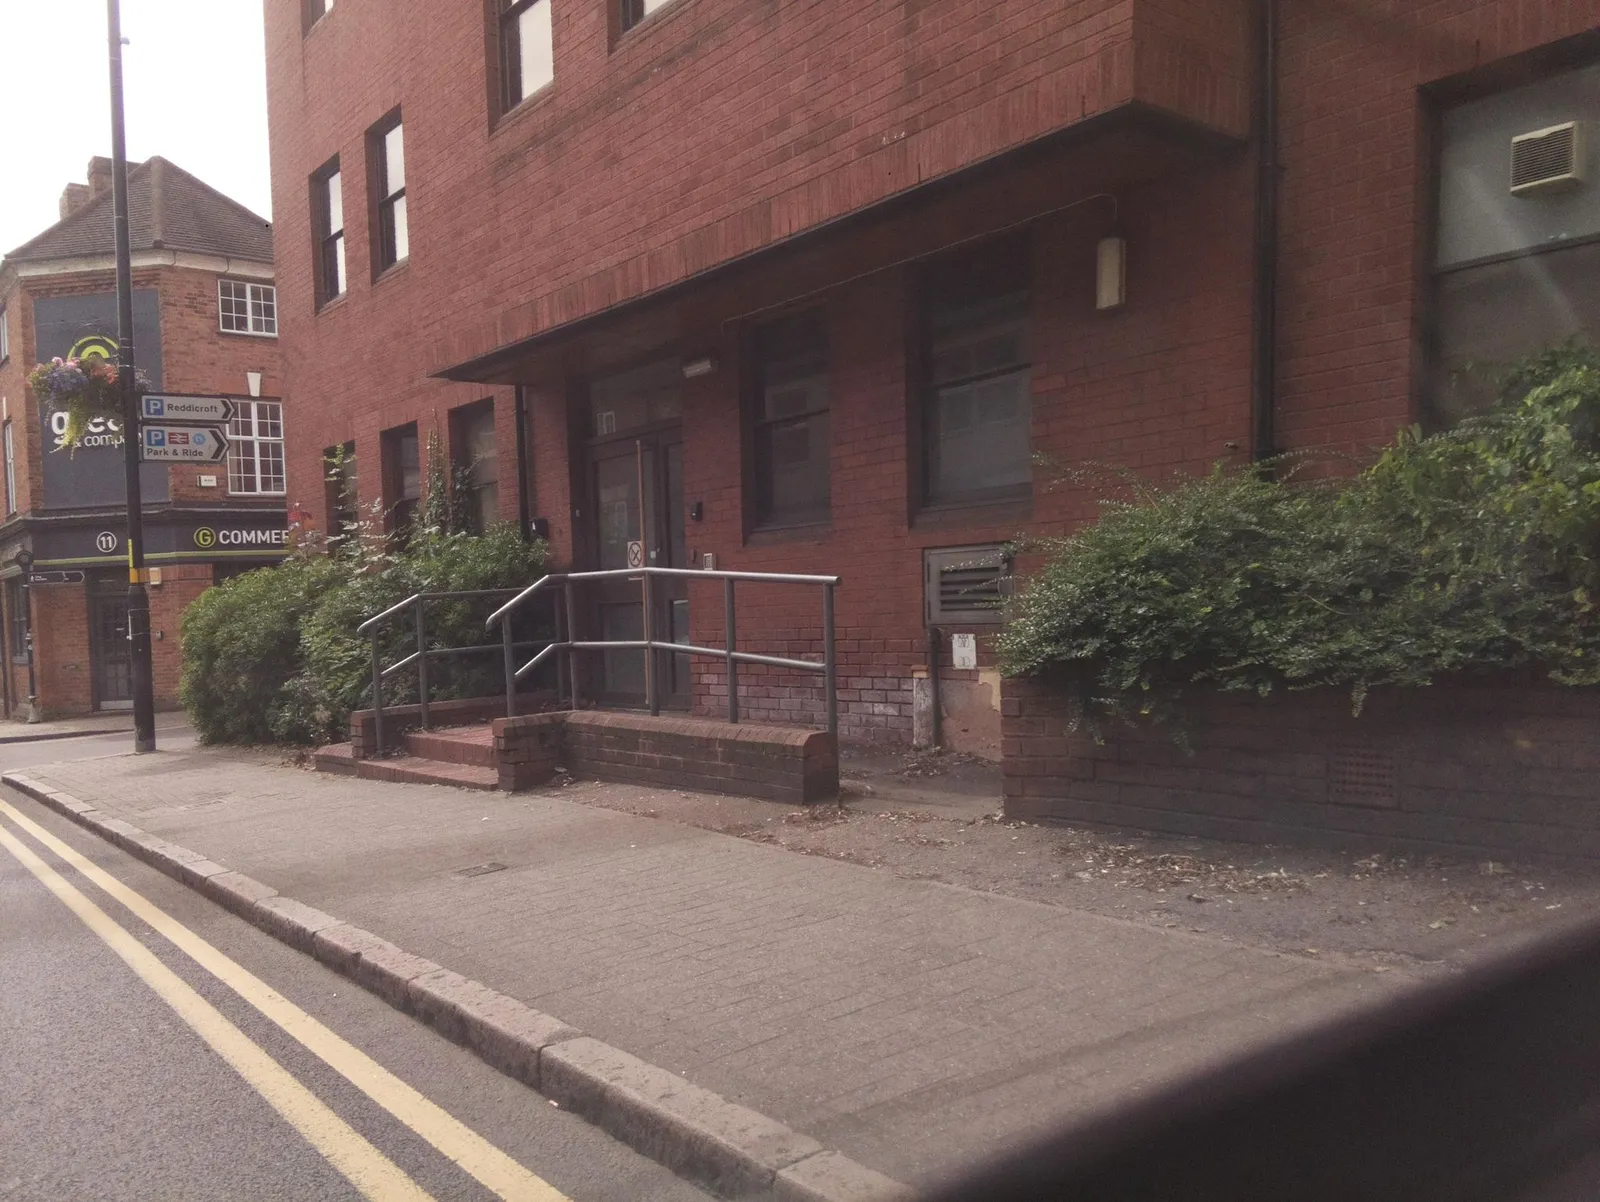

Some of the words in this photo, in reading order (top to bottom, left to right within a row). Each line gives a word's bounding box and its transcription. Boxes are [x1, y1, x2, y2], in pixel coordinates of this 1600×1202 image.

[149, 400, 161, 414] P
[167, 403, 218, 413] Reddicroft
[150, 431, 162, 445] P
[147, 448, 169, 456] Park
[172, 448, 179, 456] &
[182, 448, 204, 457] Ride
[100, 535, 112, 549] 11
[199, 529, 211, 545] G
